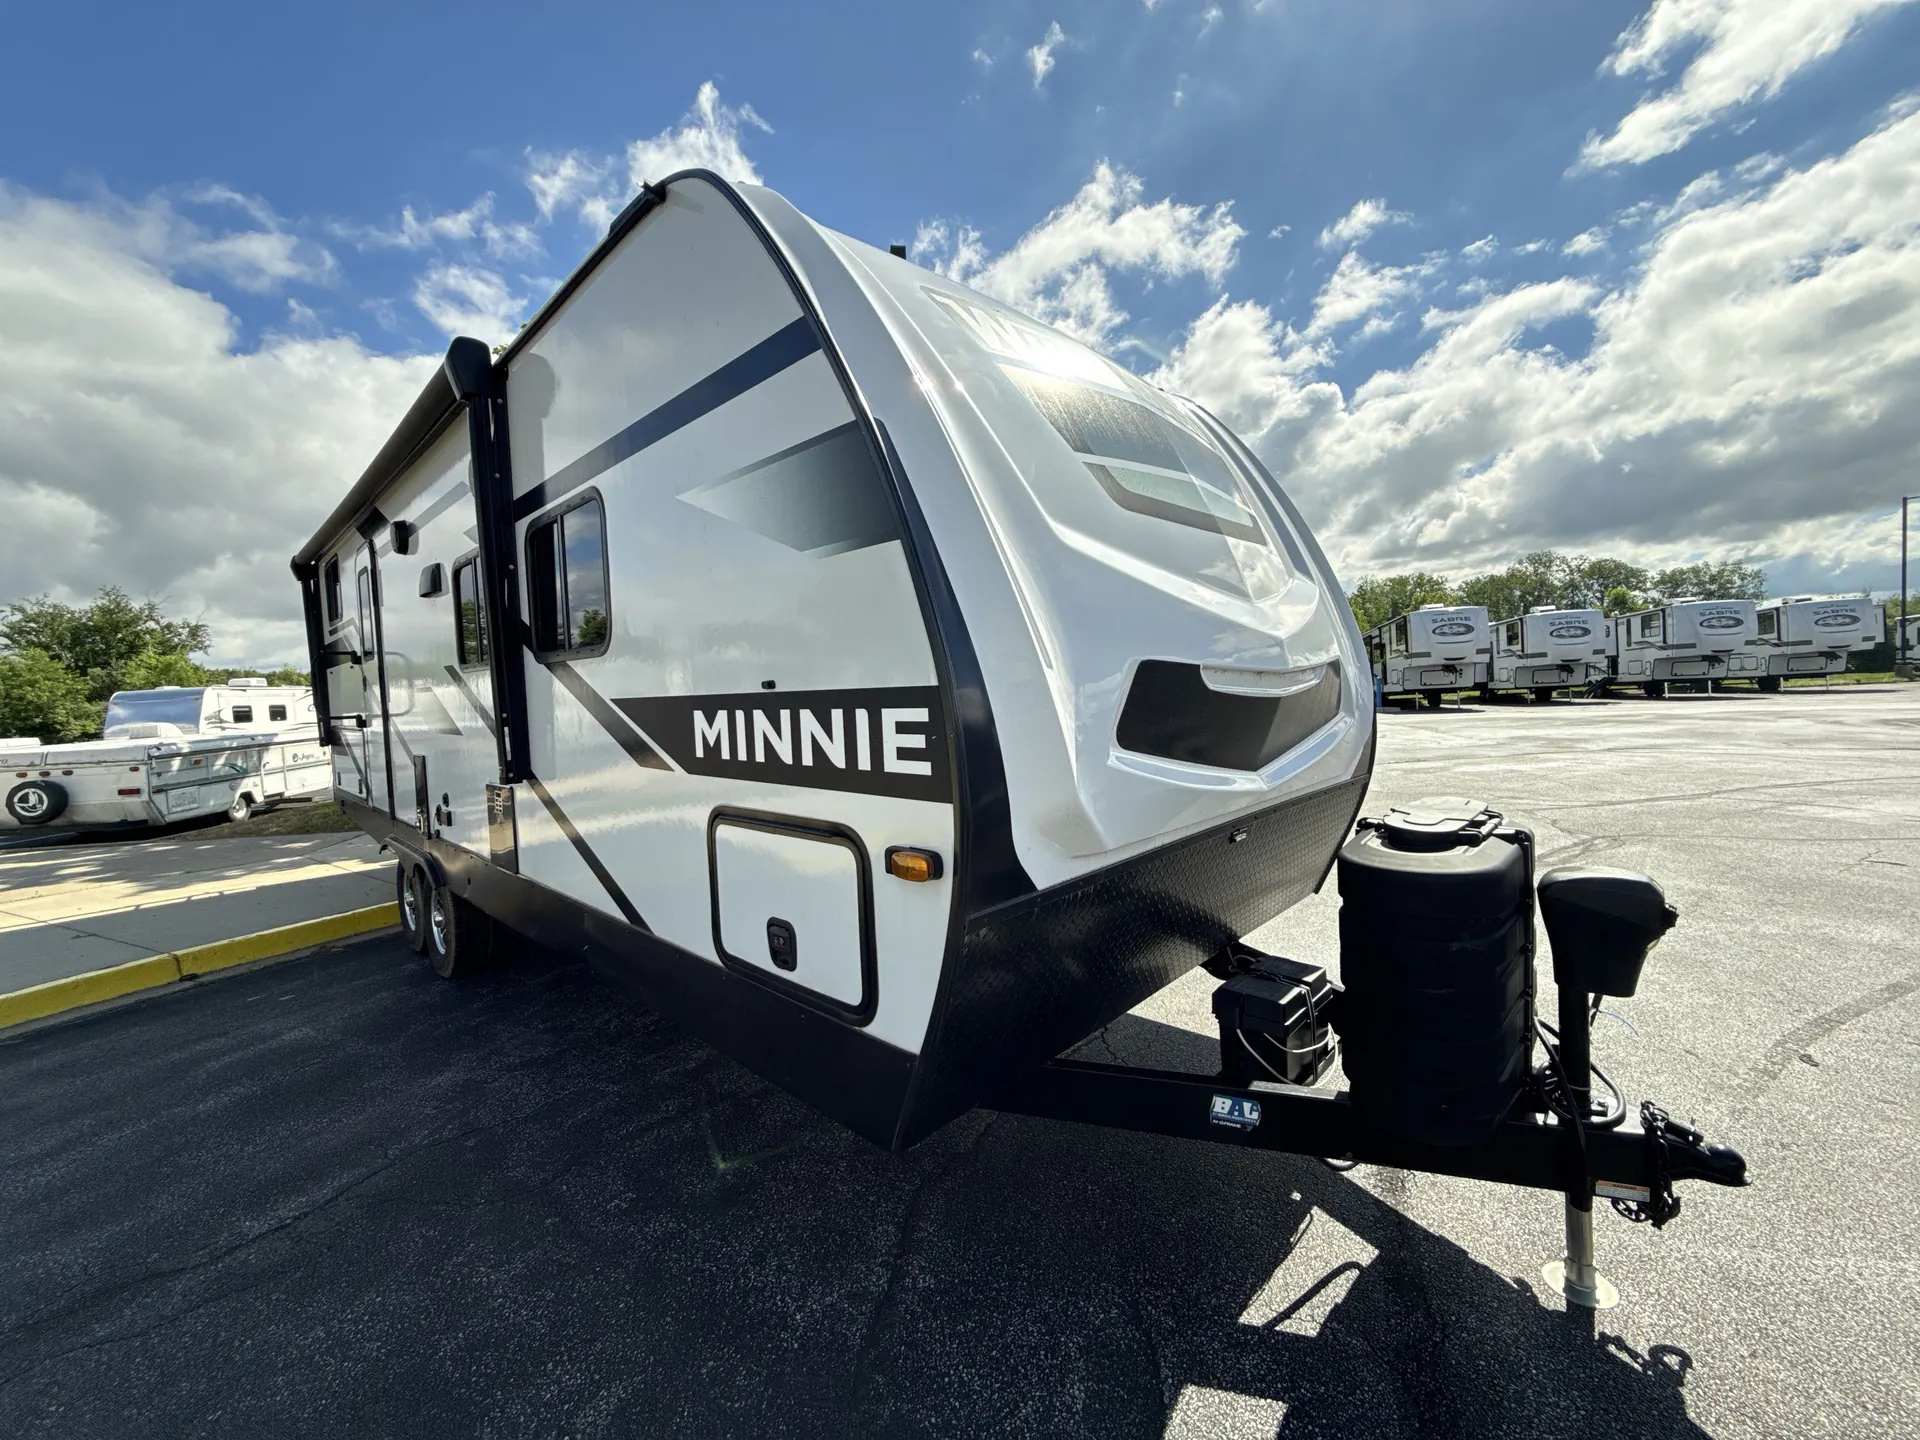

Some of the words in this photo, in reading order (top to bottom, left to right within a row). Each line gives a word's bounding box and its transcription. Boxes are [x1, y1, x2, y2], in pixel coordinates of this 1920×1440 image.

[1431, 616, 1472, 624] SABRE
[1812, 608, 1857, 616] SABRE
[693, 708, 932, 776] MINNIE
[1213, 1096, 1259, 1120] BAL
